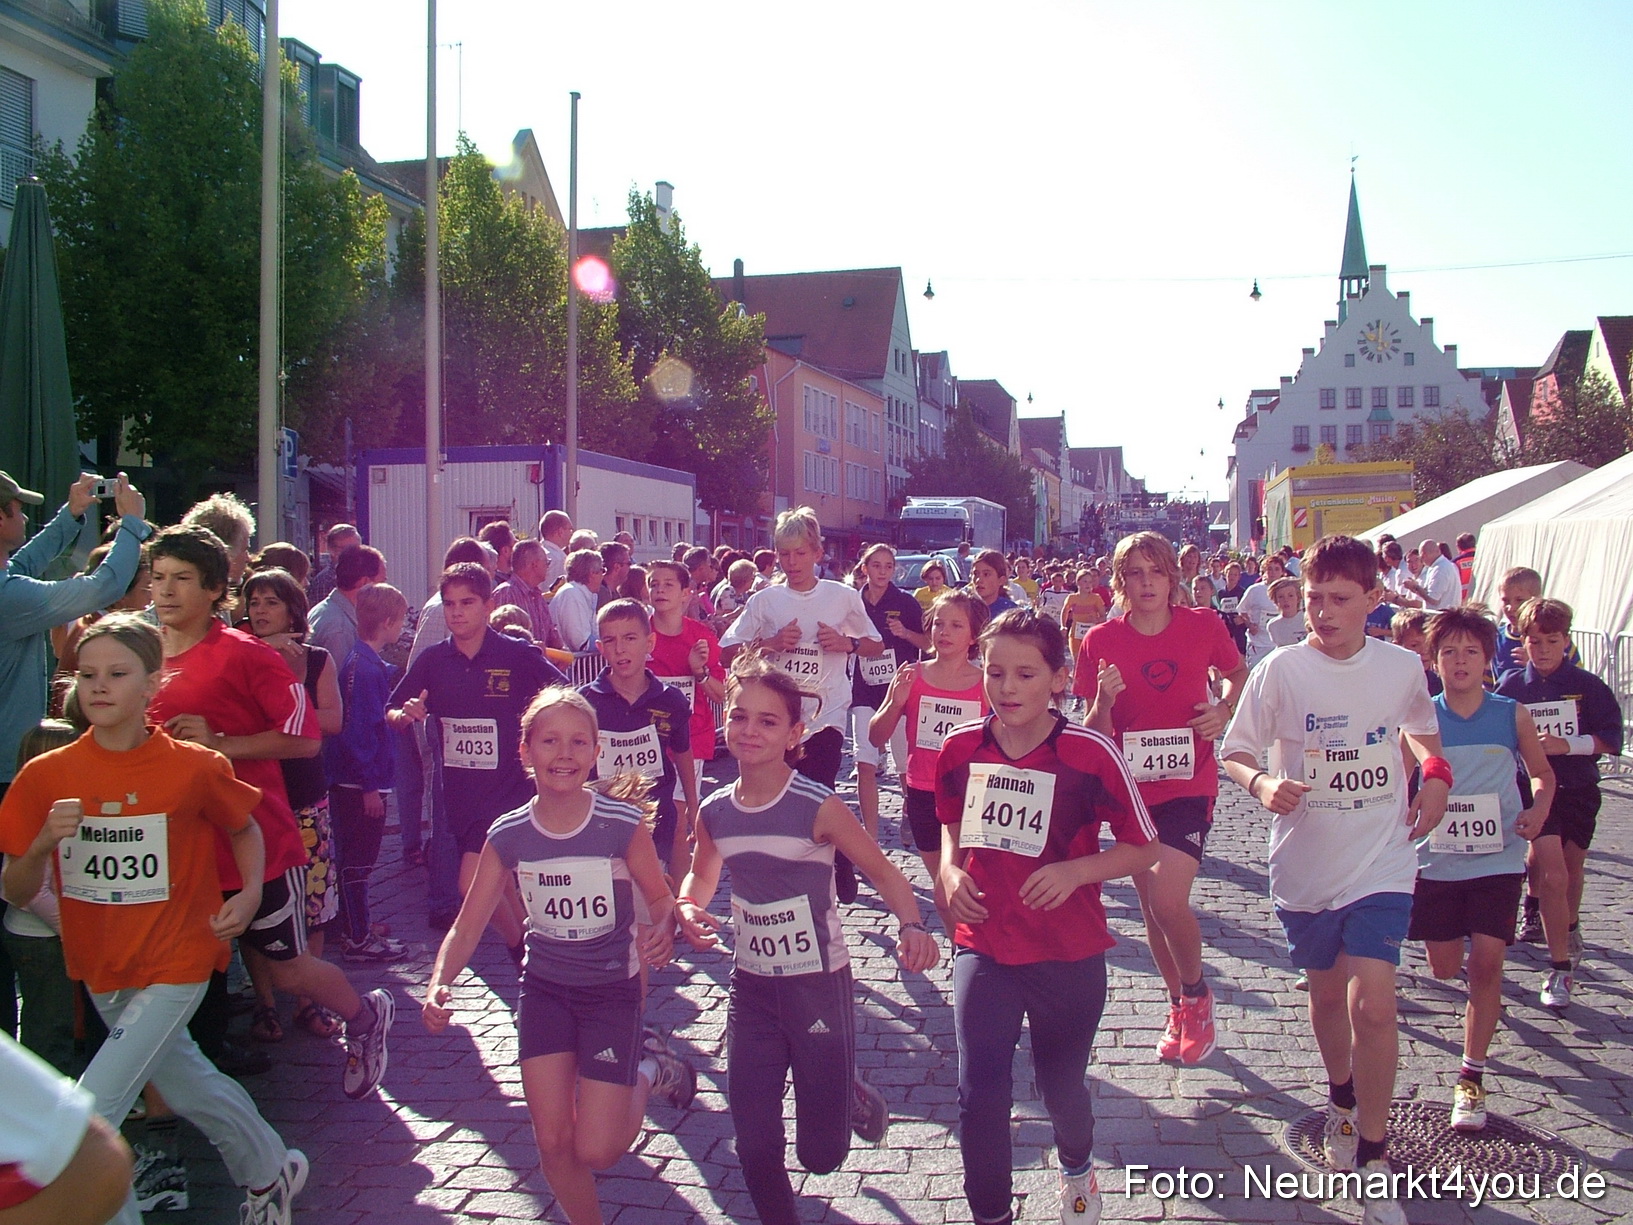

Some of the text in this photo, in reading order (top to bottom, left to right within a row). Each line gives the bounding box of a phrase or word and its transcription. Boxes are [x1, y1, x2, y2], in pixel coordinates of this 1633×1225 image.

[284, 433, 294, 470] P
[784, 659, 819, 675] 4128
[869, 663, 894, 676] 4093
[935, 703, 962, 716] Katrin
[1530, 708, 1560, 718] Florian
[921, 715, 927, 724] J
[1323, 721, 1349, 730] Stadtlauf
[452, 723, 494, 734] Sebastian
[933, 720, 955, 737] 40
[455, 740, 493, 756] 4033
[610, 733, 651, 748] Benedikt
[1140, 734, 1190, 748] Sebastian
[613, 748, 657, 768] 4189
[1127, 752, 1134, 762] J
[1143, 752, 1190, 771] 4184
[1325, 748, 1360, 762] Franz
[1309, 767, 1316, 779] J
[1329, 765, 1389, 793] 4009
[986, 773, 1035, 796] Hannah
[968, 795, 976, 809] J
[981, 800, 1043, 835] 4014
[81, 825, 144, 843] Melanie
[1447, 819, 1497, 838] 4190
[63, 846, 71, 860] J
[84, 853, 159, 881] 4030
[538, 873, 572, 887] Anne
[527, 891, 533, 903] J
[544, 895, 608, 920] 4016
[742, 909, 796, 927] Vanessa
[749, 930, 811, 957] 4015
